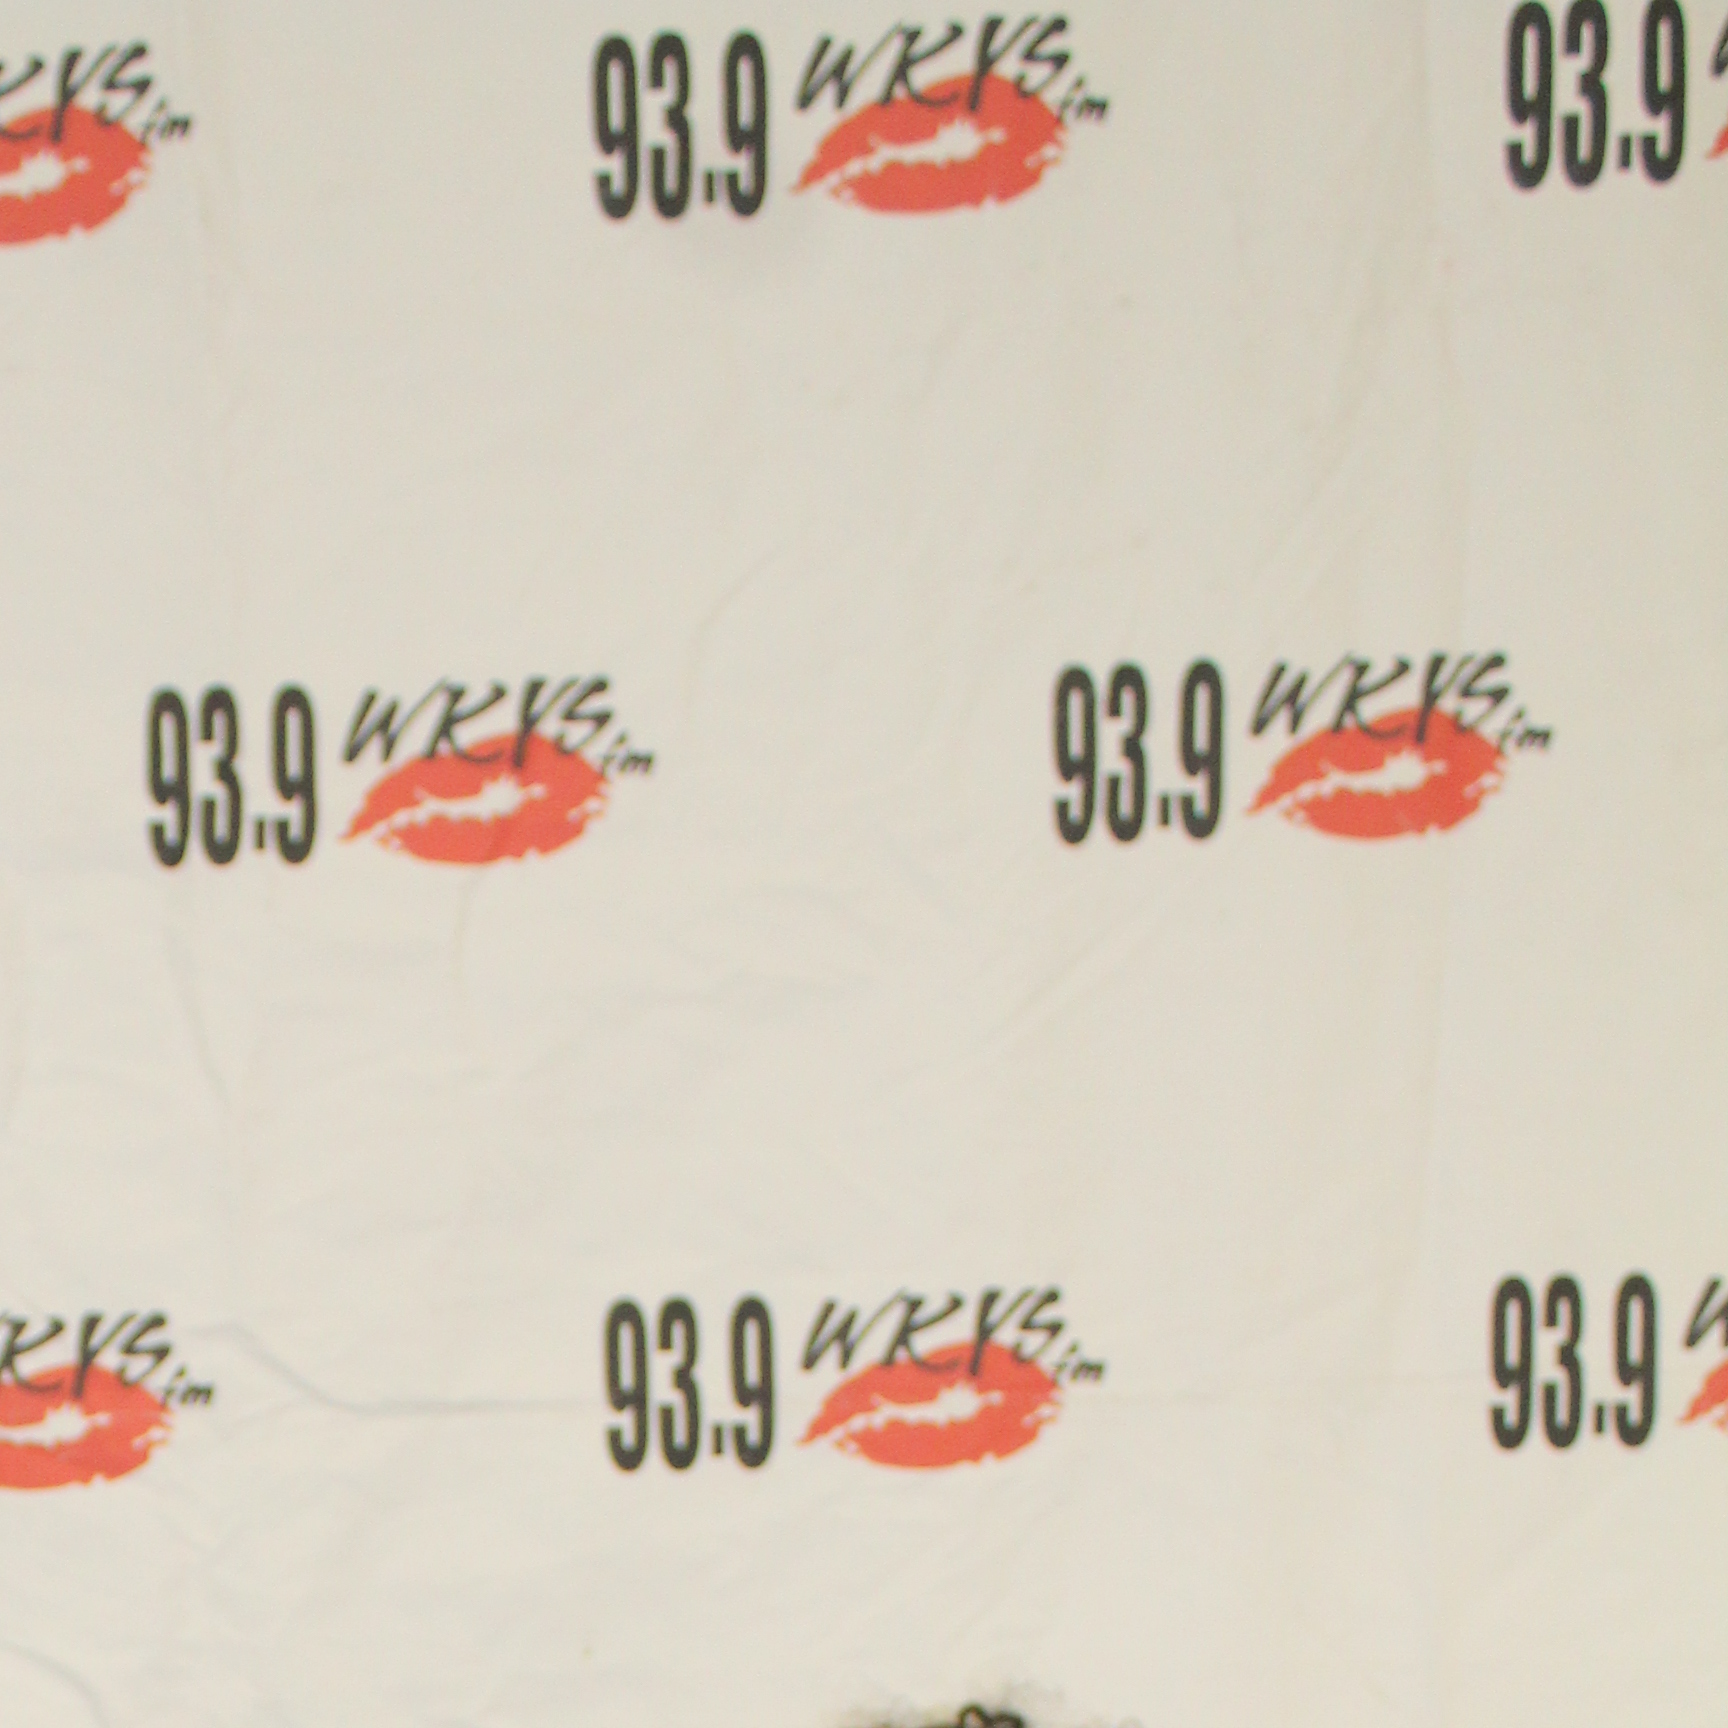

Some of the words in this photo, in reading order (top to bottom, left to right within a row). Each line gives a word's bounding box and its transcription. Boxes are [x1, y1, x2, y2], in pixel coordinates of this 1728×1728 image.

[591, 30, 770, 221] 93.9
[794, 14, 1075, 115] WKYS
[1504, 0, 1689, 192] 93.9
[146, 684, 319, 869] 93.9
[342, 677, 614, 769] WKYS
[1052, 658, 1226, 846] 93.9
[1250, 653, 1513, 745] WKYS
[603, 1295, 776, 1473] 93.9
[802, 1288, 1065, 1378] WKYS
[1490, 1272, 1659, 1451] 93.9
